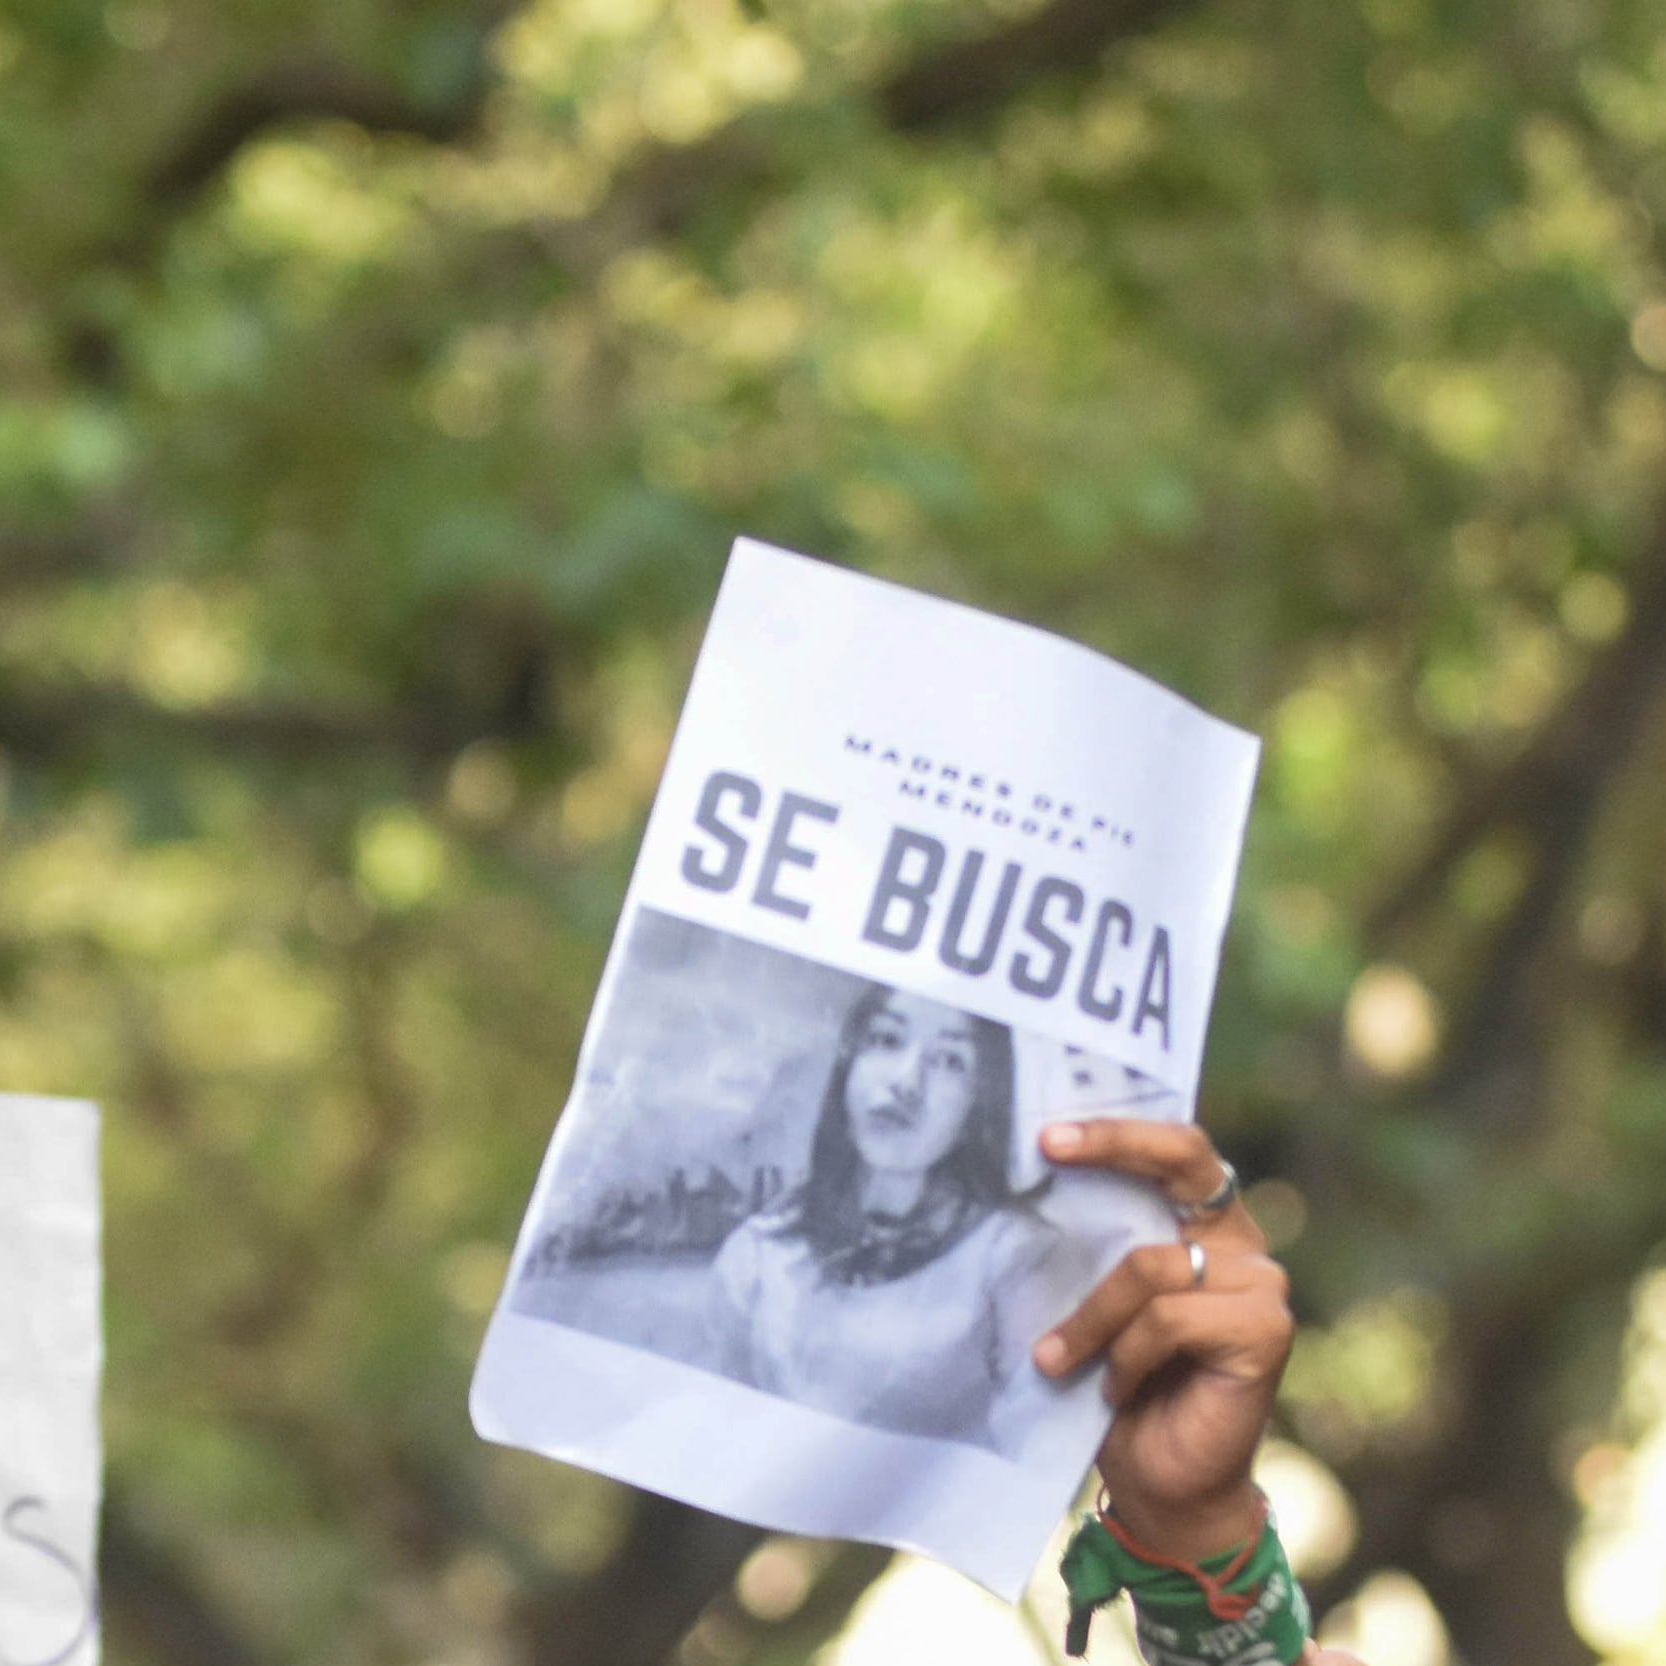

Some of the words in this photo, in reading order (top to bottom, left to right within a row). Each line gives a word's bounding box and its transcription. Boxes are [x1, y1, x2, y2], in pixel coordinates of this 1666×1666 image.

[899, 779, 1087, 851] MENDOZA
[679, 770, 841, 921] SE
[863, 826, 1174, 1053] BUSCA
